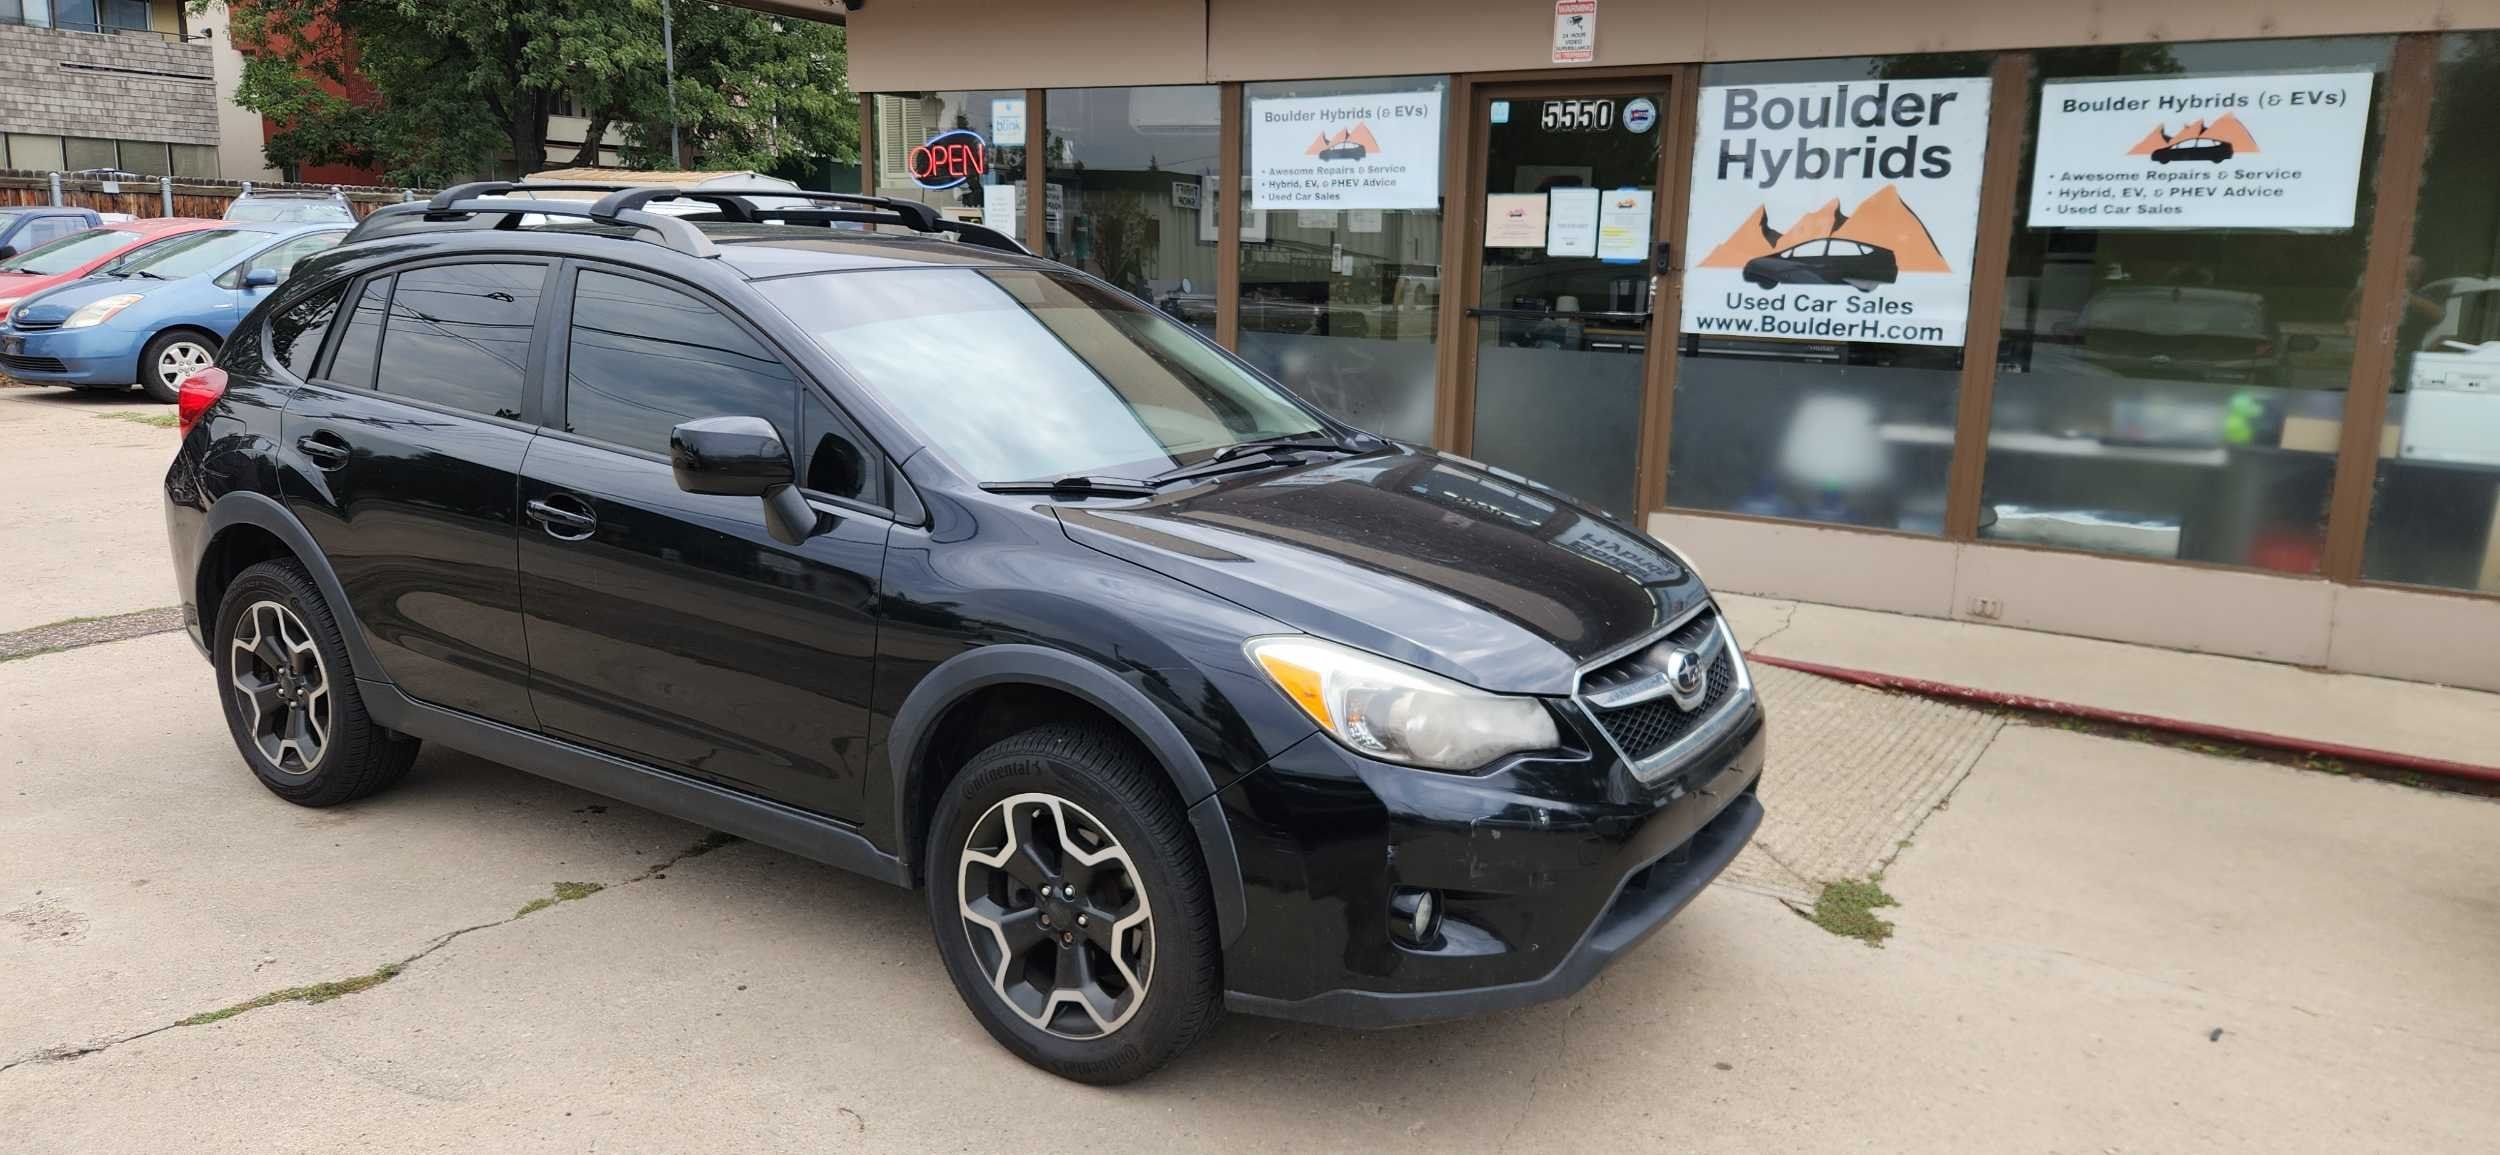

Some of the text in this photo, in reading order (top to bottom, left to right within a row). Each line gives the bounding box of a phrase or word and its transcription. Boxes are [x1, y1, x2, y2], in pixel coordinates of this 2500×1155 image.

[1723, 83, 1958, 130] Boulder
[2062, 96, 2150, 113] Boulder
[2158, 92, 2249, 113] Hybrids
[2290, 89, 2347, 107] EVs)
[1265, 110, 1315, 123] Boulder
[1320, 107, 1372, 123] Hybrids
[1394, 104, 1428, 118] EVs)
[1542, 100, 1615, 131] 5550
[909, 143, 984, 178] OPEN
[1269, 167, 1314, 176] Awesome
[1317, 166, 1354, 177] Repairs
[1367, 165, 1406, 174] Service
[1717, 135, 1953, 189] Hybrids
[1268, 180, 1300, 190] Hybrid,
[1304, 179, 1320, 189] EV,
[1331, 179, 1360, 188] PHEV
[1362, 178, 1397, 187] Advice
[2060, 171, 2140, 182] Awesome
[2146, 169, 2211, 183] Repairs
[2234, 168, 2302, 180] Service
[1268, 192, 1341, 201] Used Car Sales
[2058, 187, 2116, 201] Hybrid,
[2122, 187, 2147, 198] EV,
[2169, 186, 2217, 197] PHEV
[2223, 186, 2284, 197] Advice
[2057, 203, 2184, 215] Used Car Sales
[1726, 292, 1914, 314] Used Car Sales
[1696, 315, 1944, 341] www.BoulderH.com
[962, 760, 1030, 800] Continental
